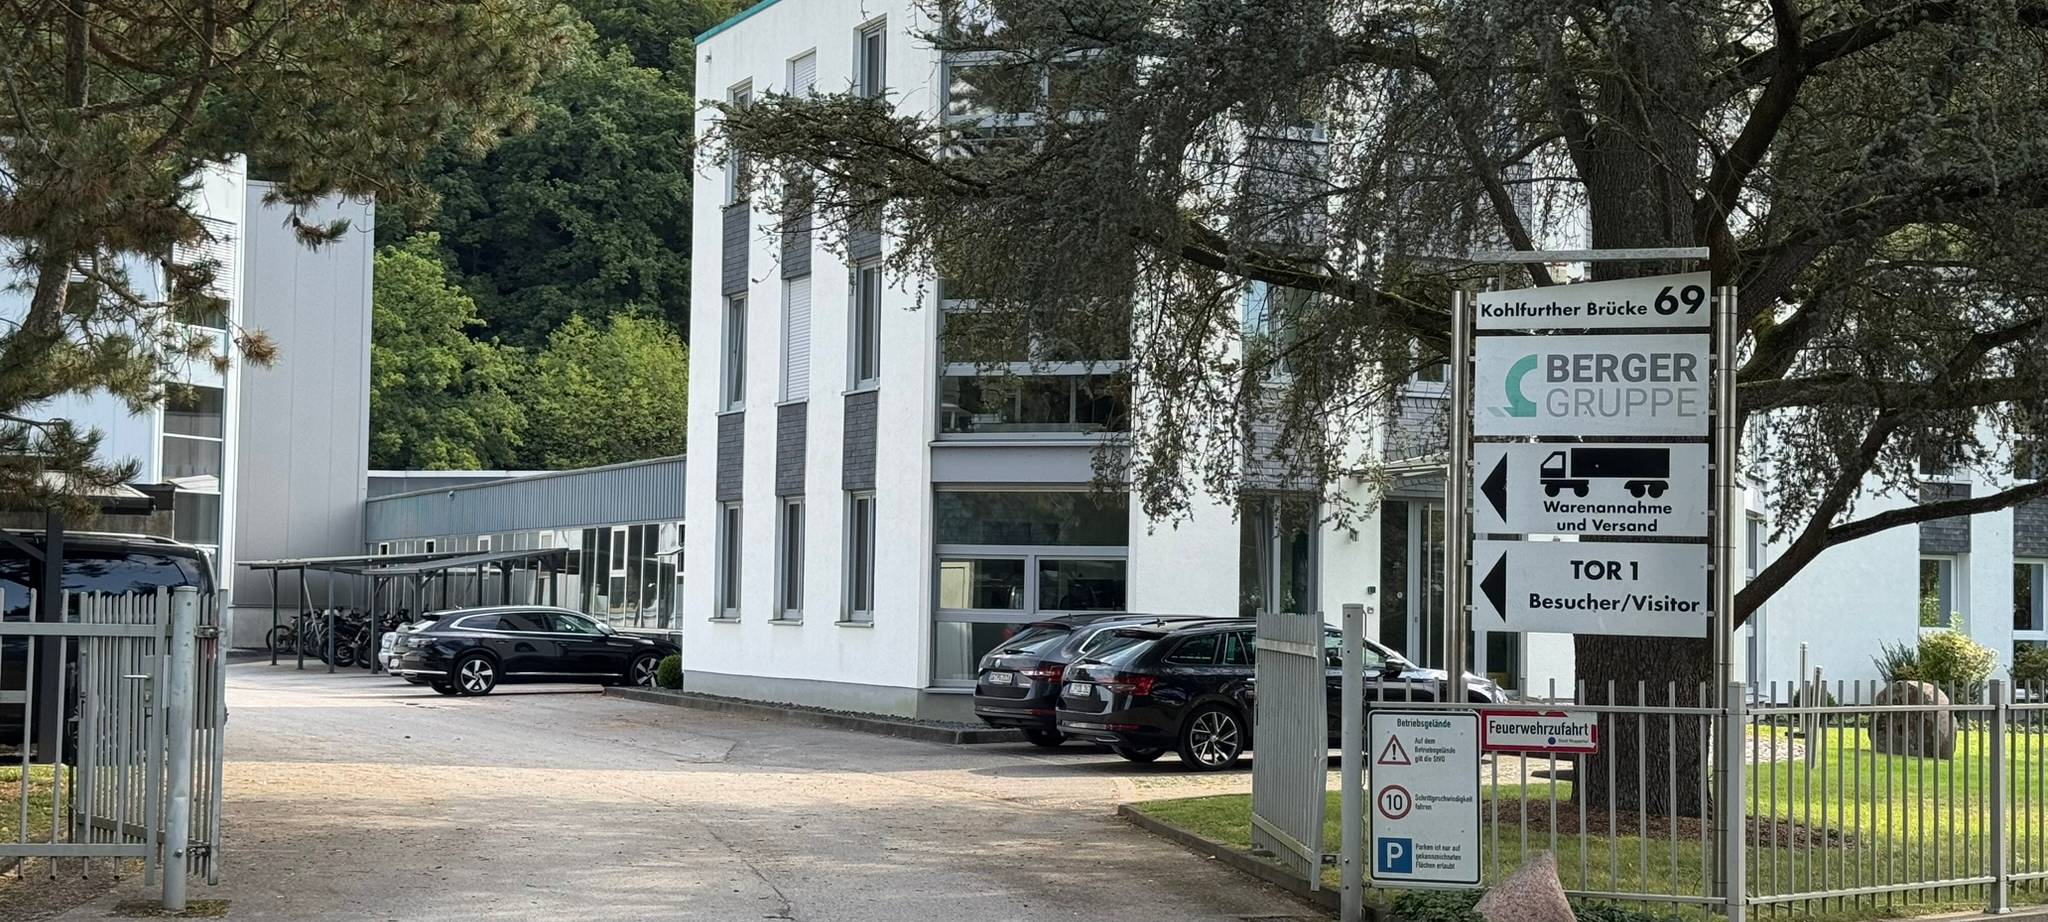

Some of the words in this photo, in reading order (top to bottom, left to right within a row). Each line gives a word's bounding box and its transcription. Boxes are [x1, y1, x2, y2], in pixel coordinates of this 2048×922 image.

[1481, 302, 1581, 318] Kohlfurther
[1587, 301, 1648, 316] Brücke
[1654, 285, 1705, 316] 69
[1547, 353, 1698, 383] BERGER
[1546, 388, 1698, 418] GRUPPE
[1544, 501, 1673, 515] Warenannahme
[1557, 519, 1586, 532] und
[1592, 519, 1658, 532] Versand
[1570, 560, 1622, 580] TOR
[1630, 561, 1639, 581] 1
[1529, 593, 1701, 613] Besucher/Visitor
[1397, 718, 1452, 730] Betriebsgelände
[1489, 720, 1589, 736] Feuerwehrzufahrt
[1386, 794, 1403, 811] 10
[1387, 842, 1404, 869] P
